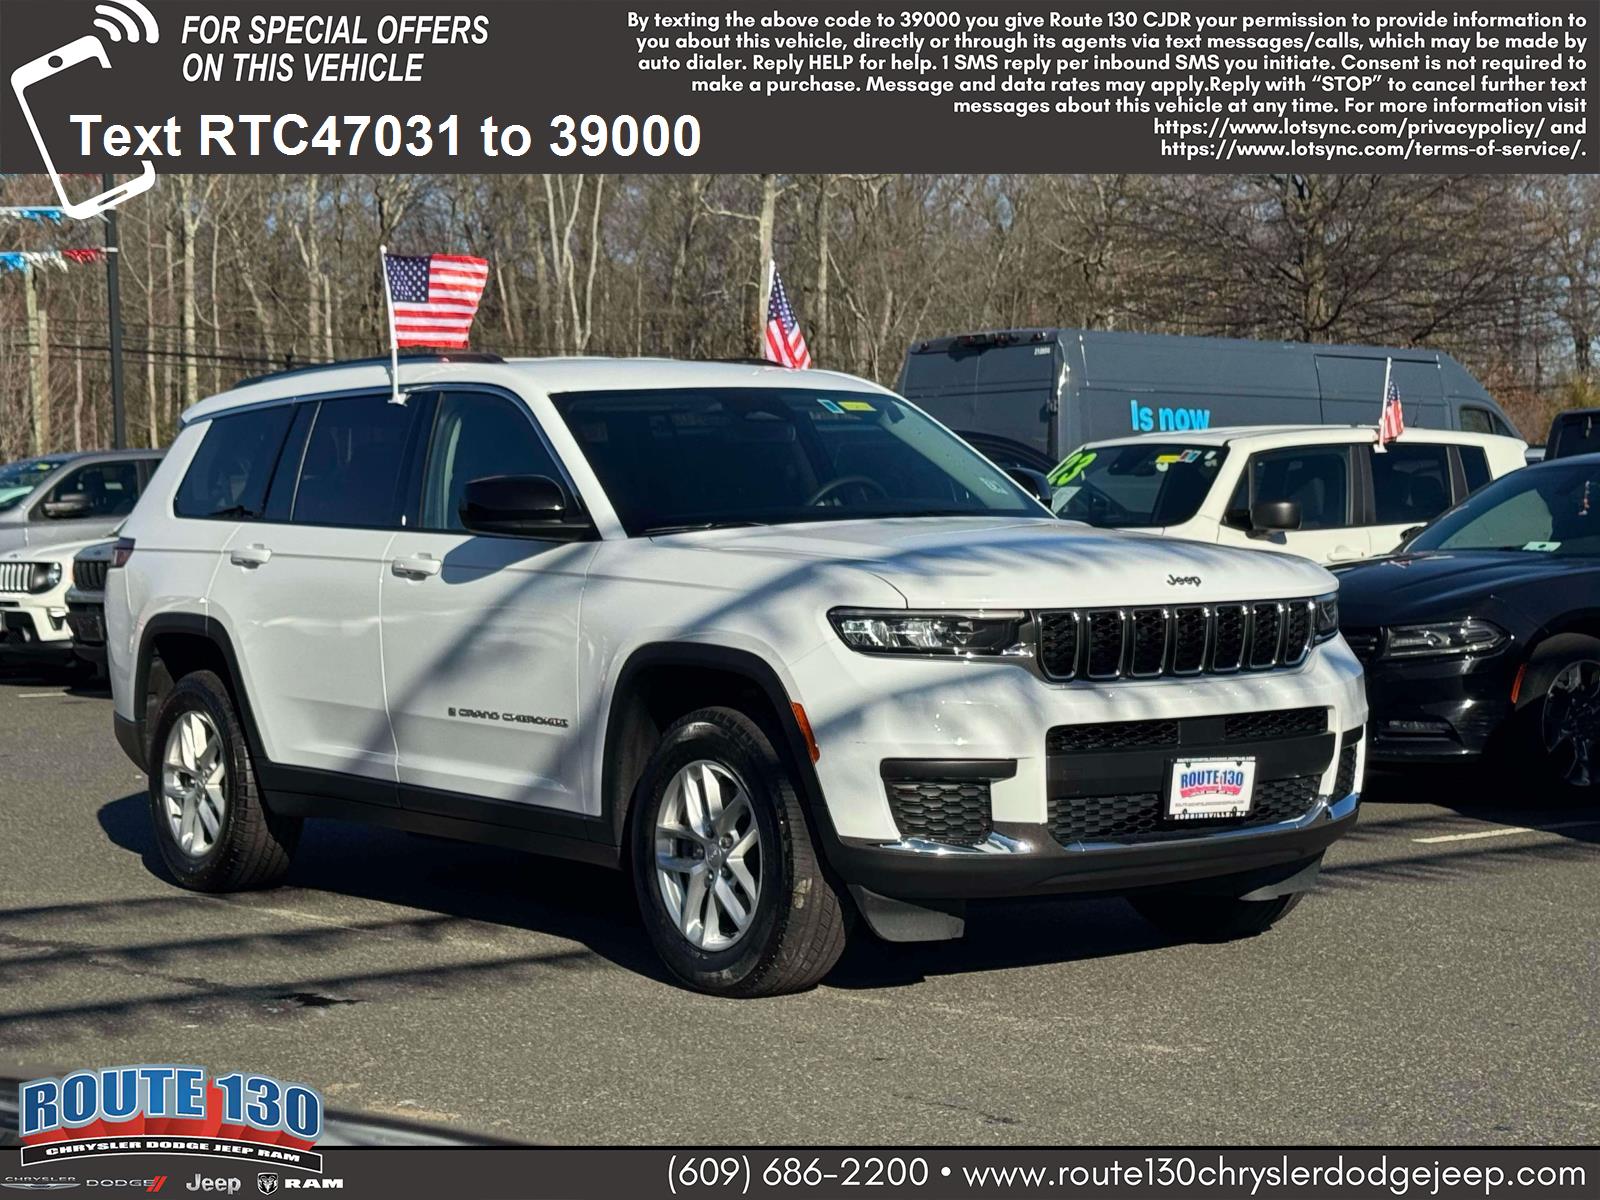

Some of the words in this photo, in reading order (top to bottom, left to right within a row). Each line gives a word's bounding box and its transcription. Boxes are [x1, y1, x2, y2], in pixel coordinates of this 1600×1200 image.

[1131, 400, 1154, 432] Is
[1158, 408, 1210, 432] now
[1166, 574, 1202, 587] Jeep
[458, 708, 500, 721] GRAND
[502, 713, 569, 728] CHEROKEE
[1181, 770, 1219, 789] ROUTE
[1222, 769, 1244, 787] 130
